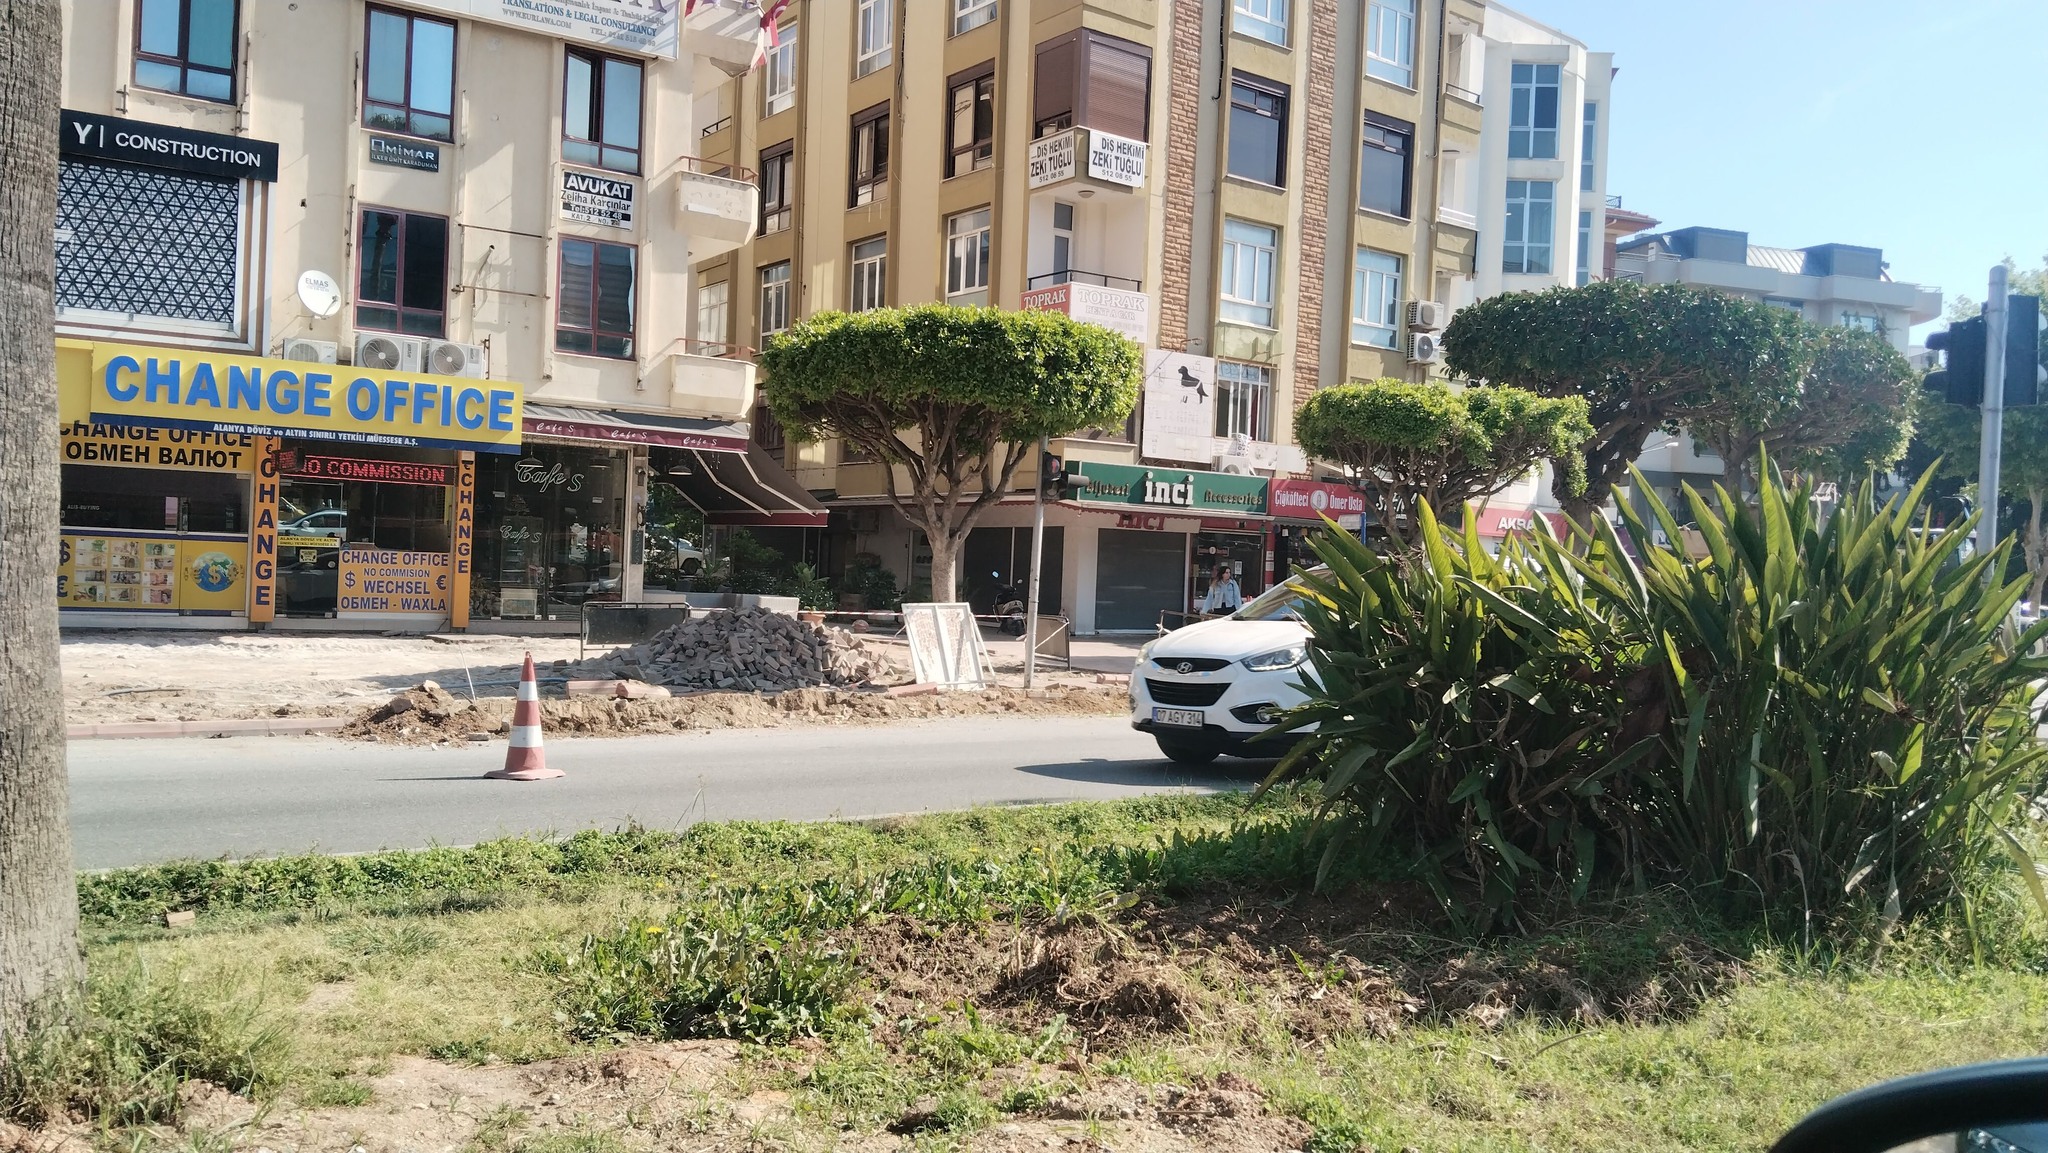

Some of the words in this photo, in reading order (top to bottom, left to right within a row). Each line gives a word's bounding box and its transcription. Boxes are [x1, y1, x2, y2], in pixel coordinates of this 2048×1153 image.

[565, 9, 572, 19] &
[574, 11, 599, 26] LEGAL
[600, 16, 658, 37] CONSULTANCY
[115, 132, 261, 168] CONSTRUCTION
[1101, 169, 1114, 178] 512
[1124, 174, 1132, 182] 55
[566, 174, 631, 199] AVUKAT
[561, 189, 588, 204] Zeliha
[590, 194, 631, 212] Karçınlar
[601, 209, 611, 218] 52
[612, 210, 623, 220] 48
[305, 277, 329, 287] ELMAS
[1023, 289, 1067, 310] TOPRAK
[1078, 289, 1145, 312] TOPRAK
[1085, 305, 1109, 317] RENT
[1117, 310, 1136, 320] CAR
[105, 355, 333, 417] CHANGE
[347, 377, 515, 431] OFFICE
[213, 423, 245, 433] ALANYA
[285, 428, 307, 438] ALTIN
[536, 422, 563, 433] Cafe
[568, 424, 575, 433] S
[610, 429, 637, 439] Cafe
[641, 431, 648, 439] S
[683, 436, 707, 446] Cafe
[711, 438, 718, 446] S
[65, 441, 150, 463] ОБМЕН
[158, 447, 242, 469] ВАЛЮТ
[327, 461, 445, 483] COMMISSION
[514, 460, 567, 493] Cafe
[567, 473, 584, 492] S
[1144, 470, 1194, 505] inci
[1329, 491, 1347, 510] Ömer
[1348, 496, 1363, 511] Usta
[255, 457, 277, 606] CHANGE
[457, 473, 473, 574] CHANGE
[341, 550, 397, 566] CHANGE
[402, 552, 449, 567] OFFICE
[364, 568, 376, 577] NO
[379, 568, 430, 578] COMMISION
[363, 580, 430, 595] WECHSEL
[341, 596, 389, 610] ОБМЕН
[401, 597, 447, 611] WAXLA
[1168, 710, 1185, 724] AGY
